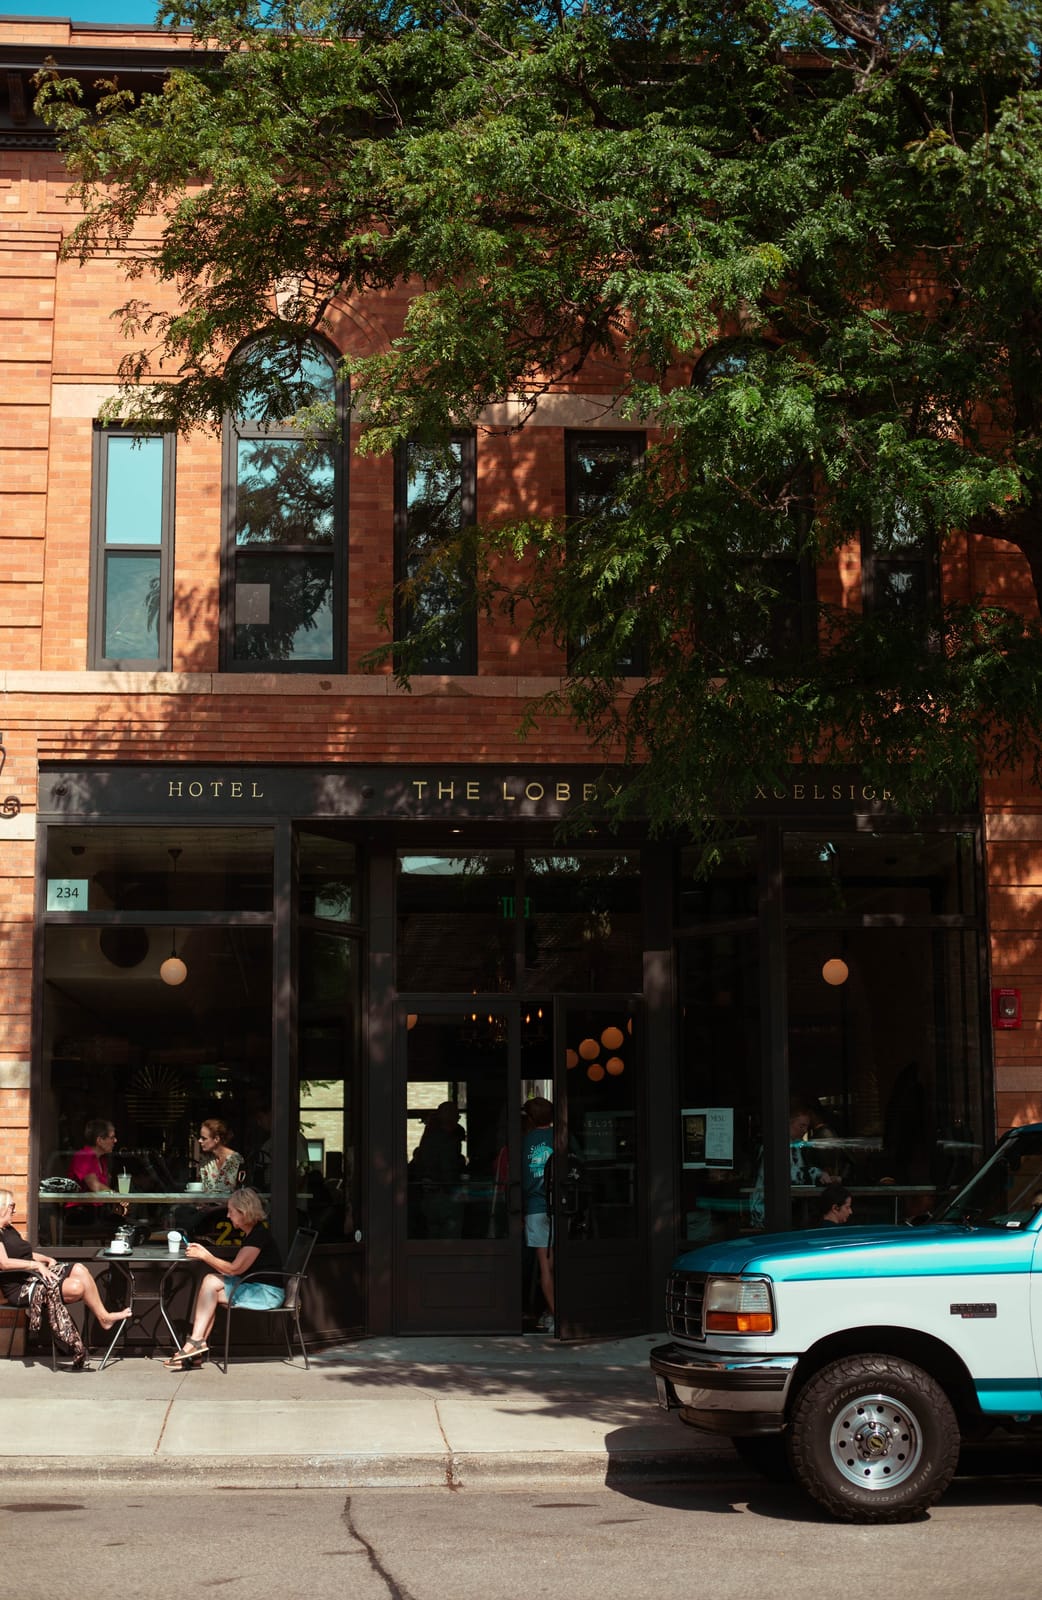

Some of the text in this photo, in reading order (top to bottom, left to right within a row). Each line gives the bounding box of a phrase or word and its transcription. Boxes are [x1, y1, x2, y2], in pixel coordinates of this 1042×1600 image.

[168, 781, 265, 799] HOTEL
[412, 780, 623, 802] THE LOBBY
[753, 783, 896, 801] XCELSIOR
[56, 887, 80, 899] 234
